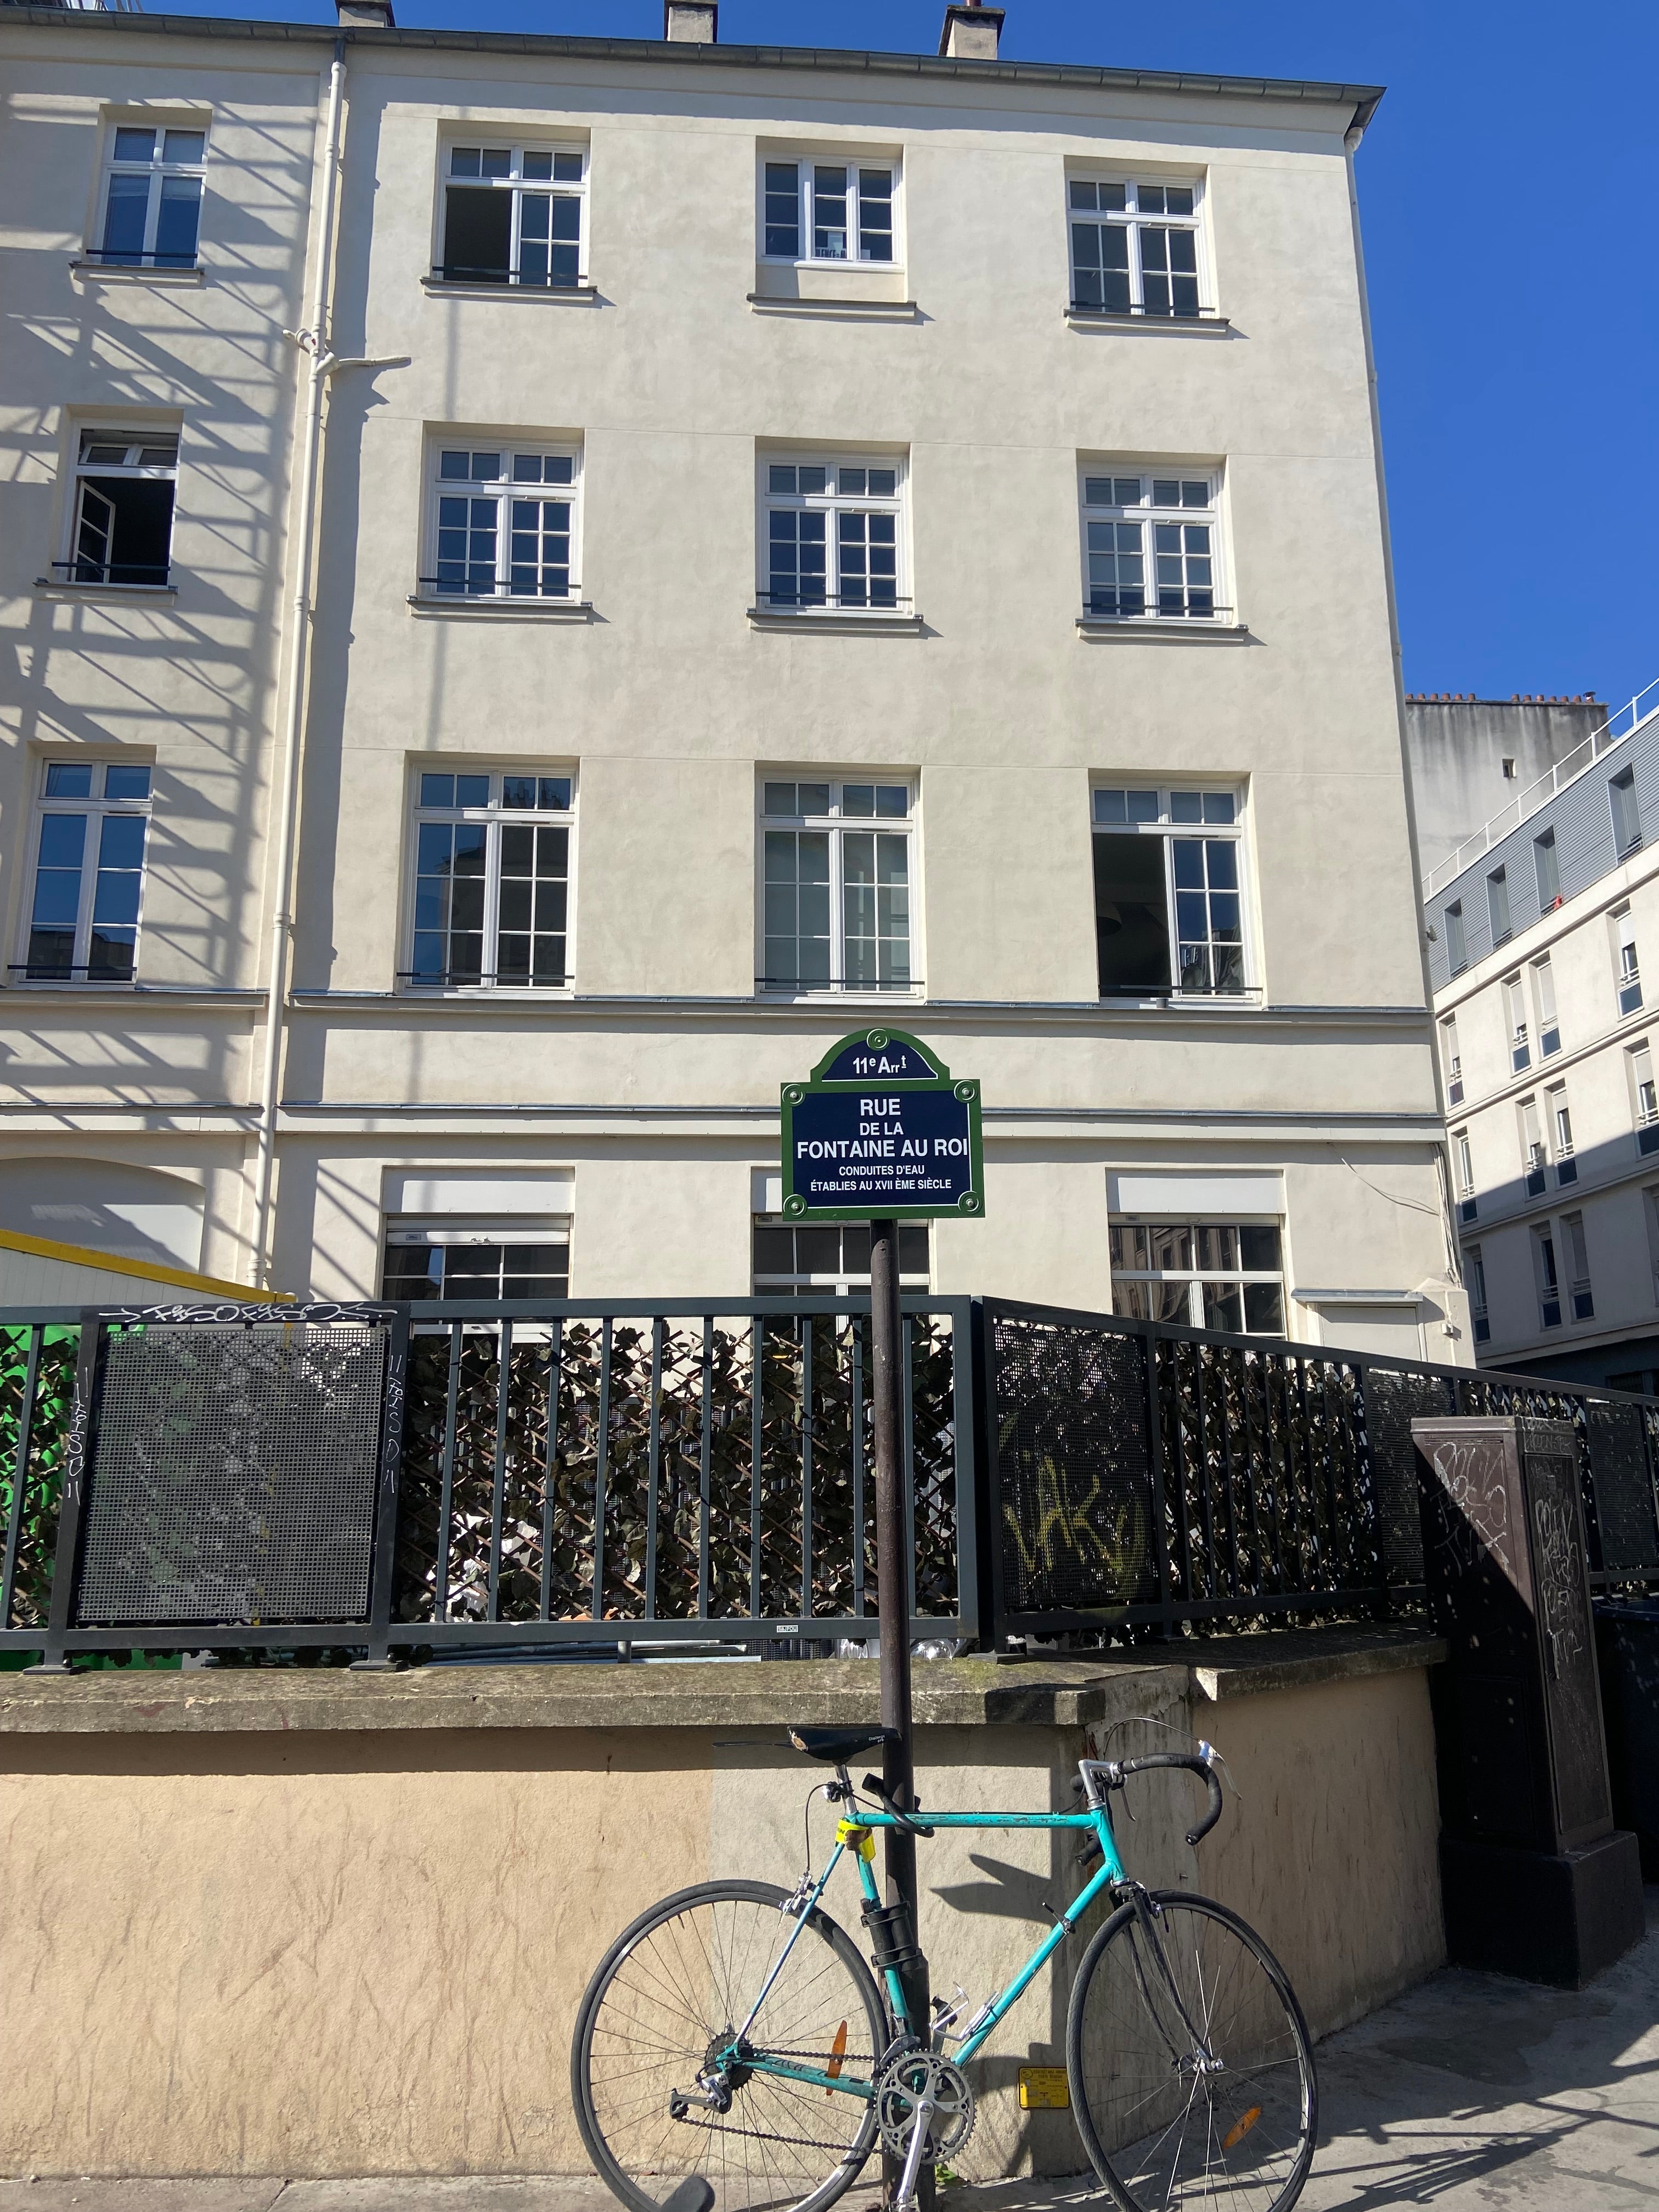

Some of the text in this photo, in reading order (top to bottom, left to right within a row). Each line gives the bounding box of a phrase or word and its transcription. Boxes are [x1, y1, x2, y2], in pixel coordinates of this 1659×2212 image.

[860, 1099, 901, 1116] RUE
[860, 1122, 904, 1135] DE LA
[797, 1138, 967, 1159] FONTAINE AU ROI
[839, 1165, 925, 1176] CONDUITES D'EAU
[810, 1177, 952, 1191] ÉTABLIES AU XVII ÈME SIÈCLE
